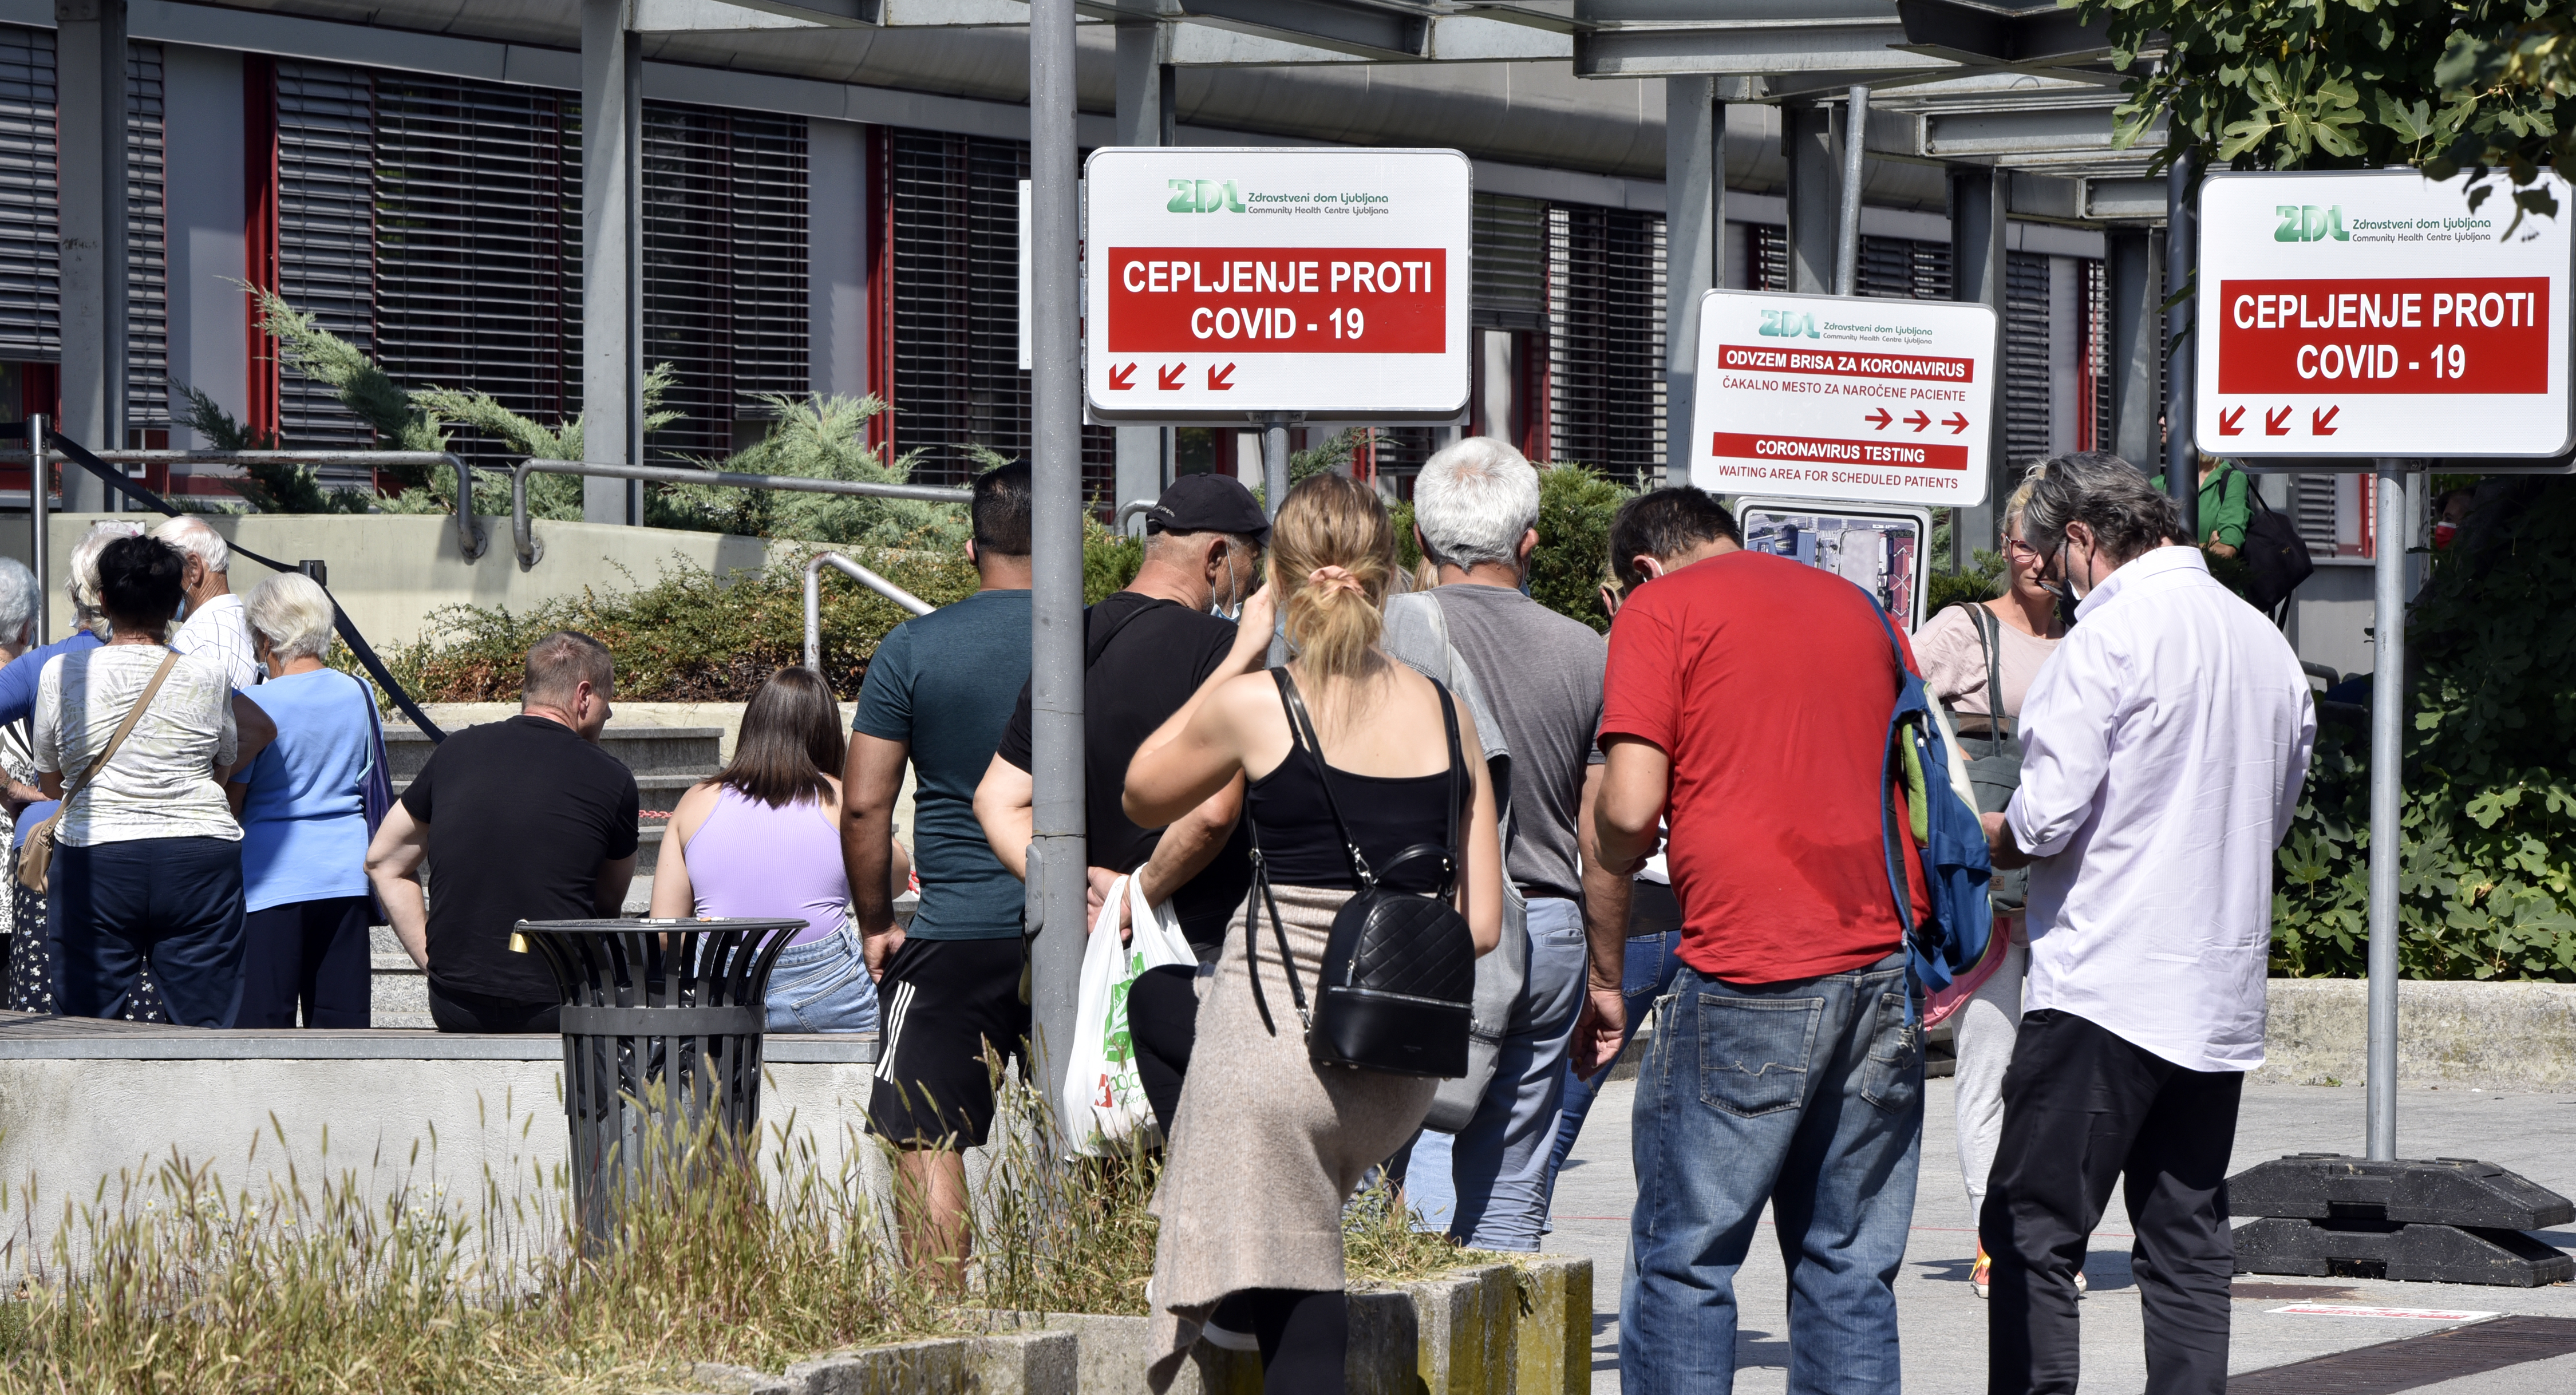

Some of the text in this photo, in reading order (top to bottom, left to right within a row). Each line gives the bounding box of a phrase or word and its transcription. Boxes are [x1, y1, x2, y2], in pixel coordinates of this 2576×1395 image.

[1167, 179, 1246, 213] ZDL
[1249, 193, 1388, 205] Zdravstveni dom Ljubljana
[1249, 206, 1292, 215] Community
[1353, 207, 1388, 216] Ljubljana
[2274, 205, 2350, 242] ZDL
[2353, 218, 2491, 231] Zdravstveni dom Ljubljana
[2353, 234, 2395, 243] Community
[2398, 233, 2423, 241] Health
[2455, 232, 2491, 243] Ljubljana
[1124, 261, 1431, 293] CEPLJENJE PROTI
[1192, 307, 1296, 339] COVID
[1330, 308, 1364, 339] 19
[2234, 293, 2534, 329] CEPLJENJE PROTI
[1759, 310, 1820, 339] ZDL
[1823, 333, 1857, 341] Community
[1824, 322, 1871, 331] Zdravstveni
[1896, 326, 1932, 336] Ljubljana
[1726, 350, 1965, 377] ODVZEM BRISA ZA KORONAVIRUS
[2297, 345, 2398, 379] COVID
[2431, 345, 2465, 378] 19
[1723, 376, 1965, 401] ČAKALNO MESTO ZA NAROČENE PACIENTE
[1756, 440, 1925, 463] CORONAVIRUS TESTING
[1720, 465, 1958, 488] WAITING AREA FOR SCHEDULED PATIENTS
